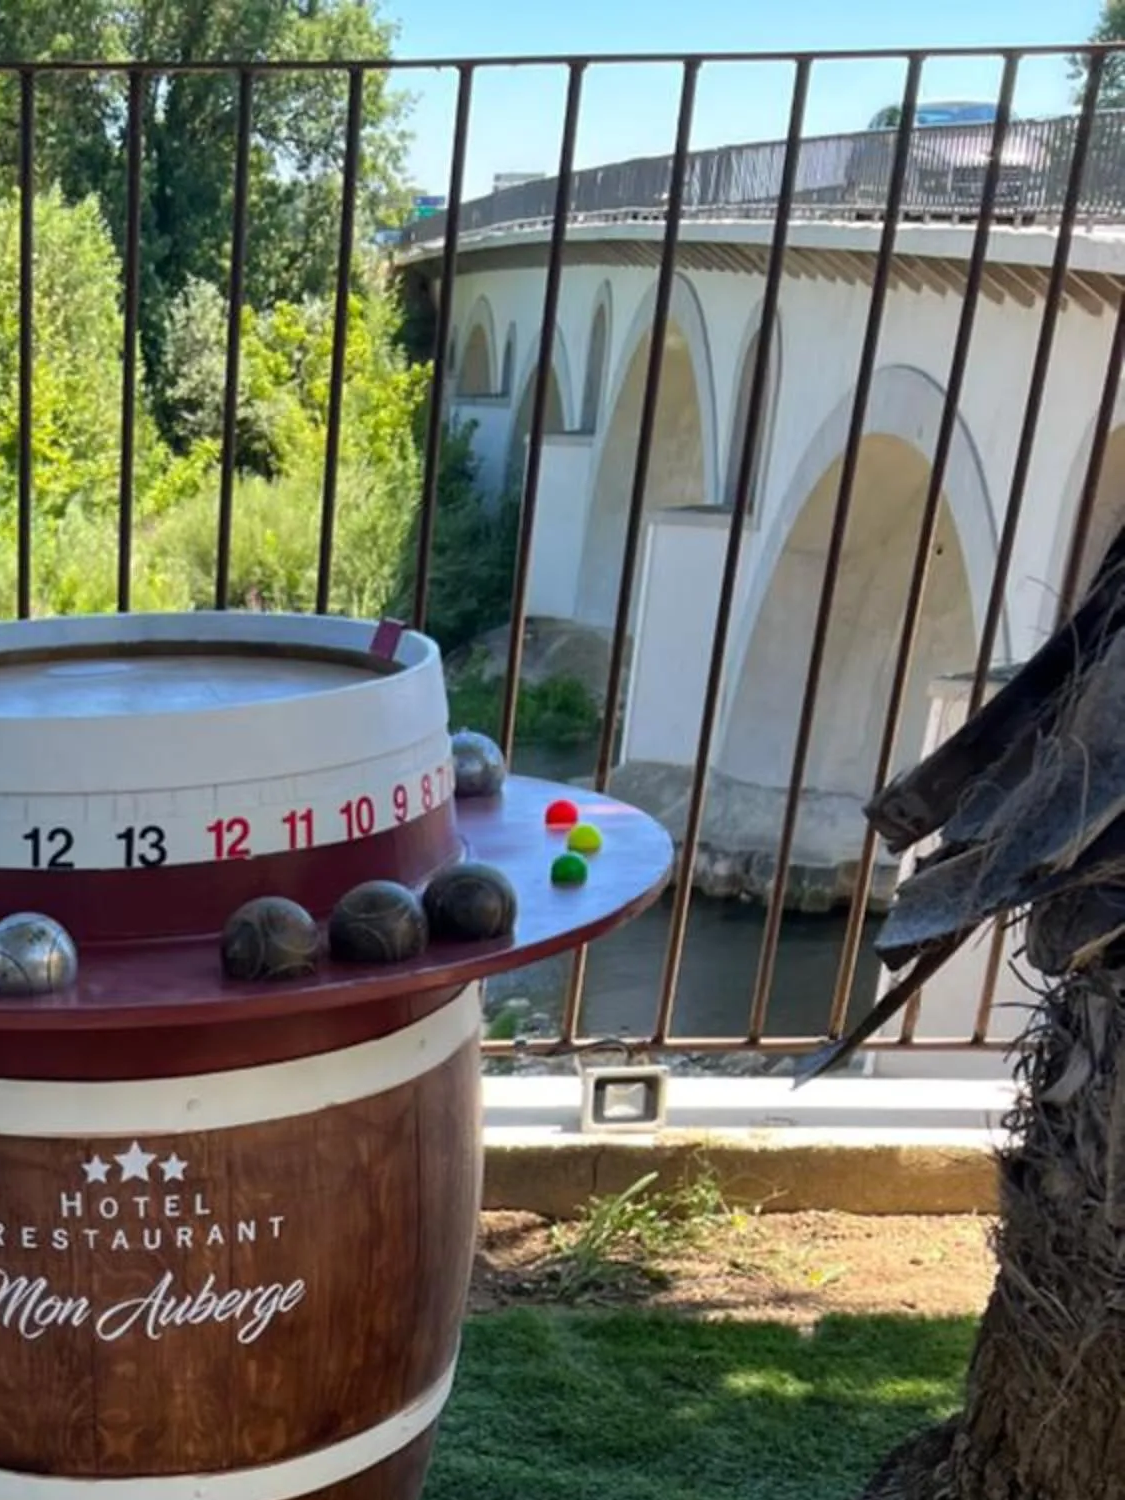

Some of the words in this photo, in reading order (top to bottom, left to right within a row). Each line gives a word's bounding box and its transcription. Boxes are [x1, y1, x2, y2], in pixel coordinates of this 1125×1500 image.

[22, 827, 75, 868] 12
[116, 826, 168, 867] 13
[206, 817, 252, 861] 12
[282, 808, 315, 850] 11
[339, 796, 375, 840] 10
[392, 784, 408, 822] 9
[421, 774, 433, 811] 8
[60, 1191, 211, 1218] HOTEL
[95, 1269, 307, 1345] Auberge
